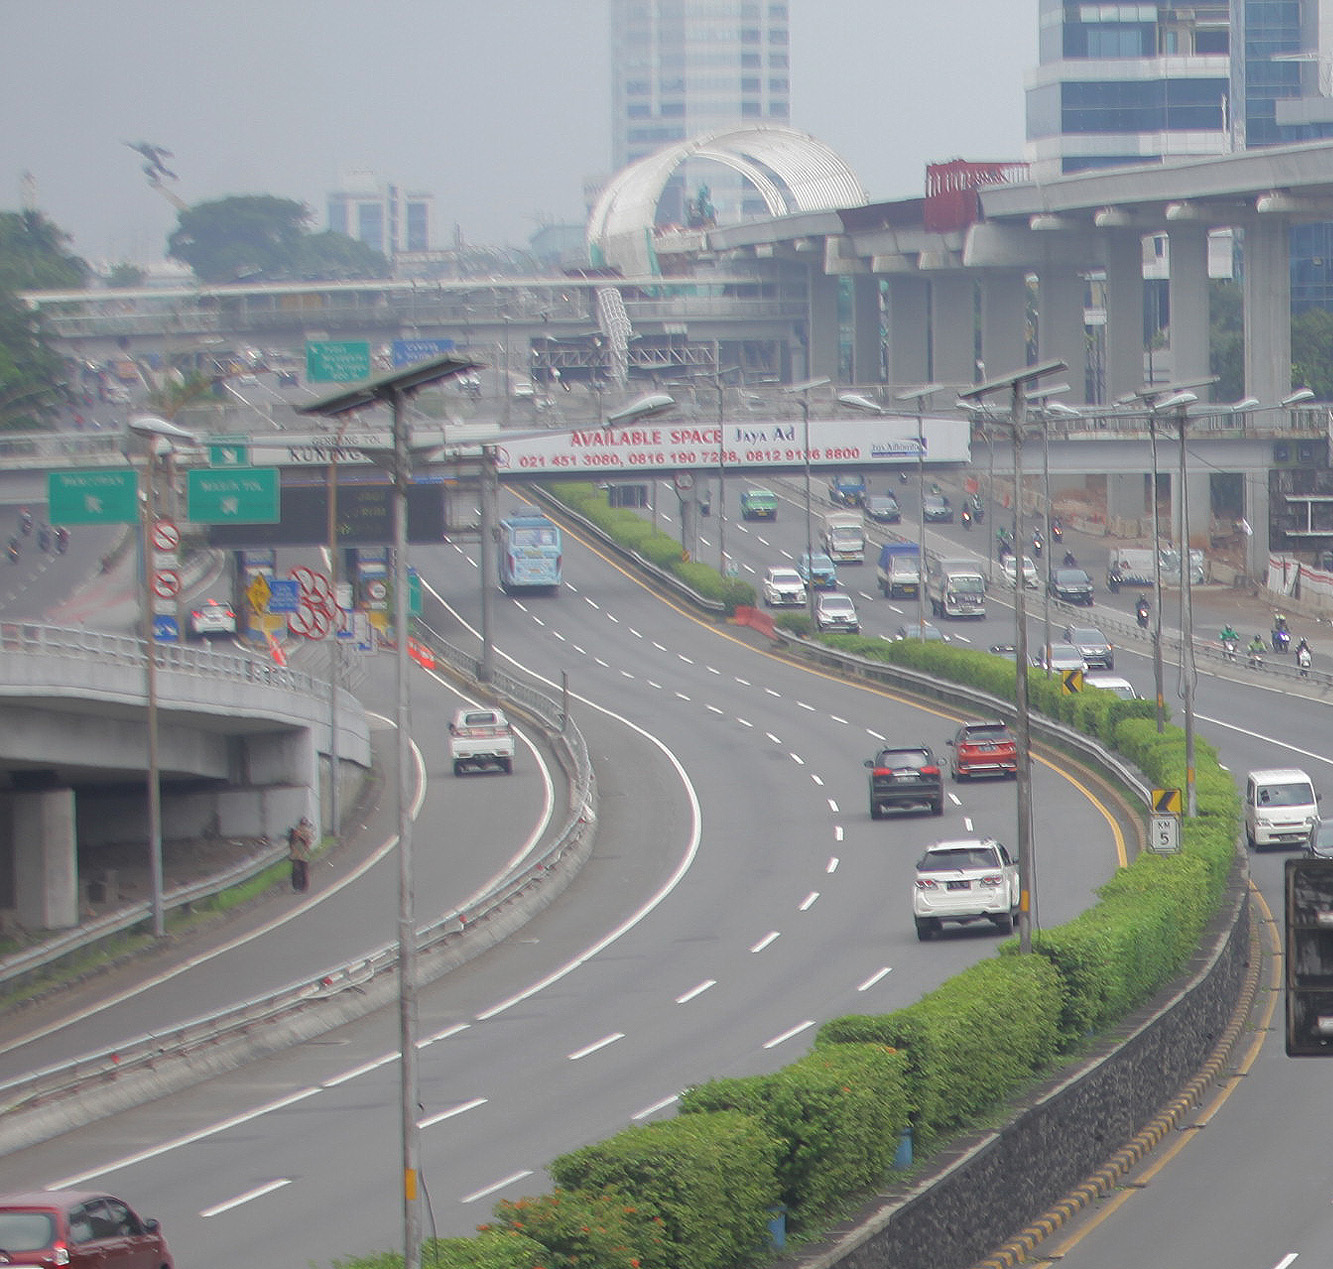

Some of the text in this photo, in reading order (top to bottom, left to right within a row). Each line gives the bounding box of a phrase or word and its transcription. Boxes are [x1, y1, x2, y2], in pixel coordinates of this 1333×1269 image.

[571, 428, 722, 447] AVAILABLE SPACE
[519, 456, 546, 468] 021
[552, 455, 577, 467] 451
[670, 451, 697, 464] 190
[1160, 832, 1170, 846] 5
